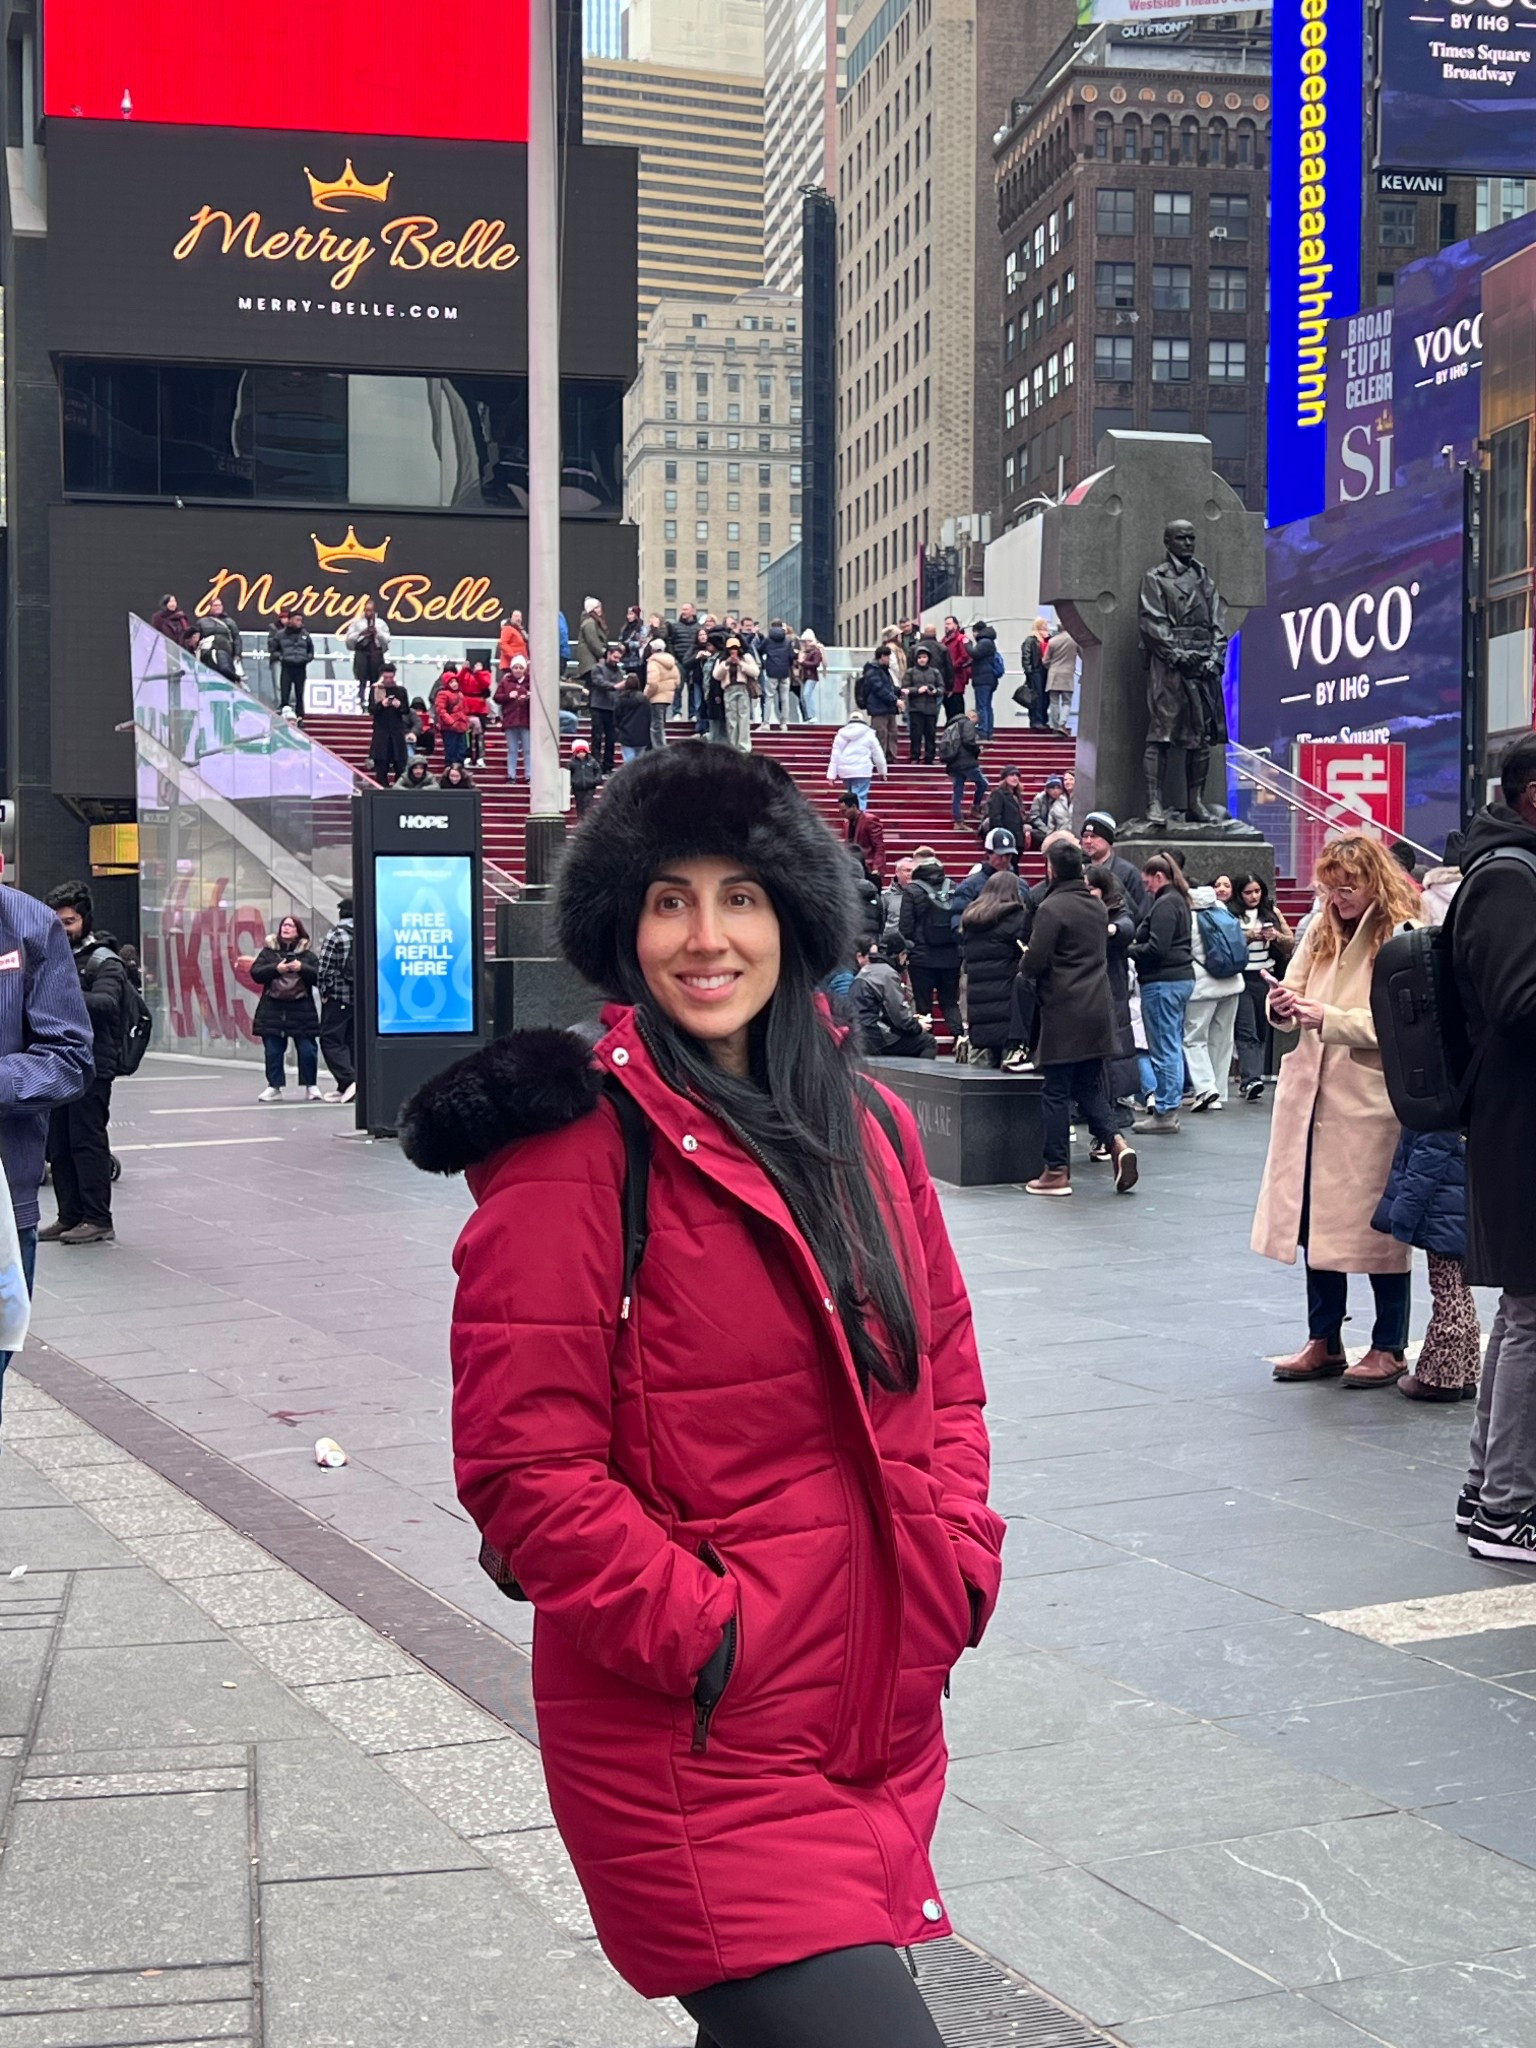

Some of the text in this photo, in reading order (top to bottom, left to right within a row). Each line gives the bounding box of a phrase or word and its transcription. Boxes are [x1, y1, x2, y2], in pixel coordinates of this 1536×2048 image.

[1451, 13, 1510, 32] BY IHG
[1428, 41, 1531, 65] Times Square
[1443, 63, 1517, 86] Broadway
[1381, 175, 1443, 192] KEVANI
[172, 205, 521, 290] Merry Belle
[238, 296, 458, 319] MERRY-BELLE.COM
[1347, 309, 1394, 346] BROAD
[1435, 362, 1469, 386] BY IHG
[1346, 371, 1393, 409] CELEBR
[194, 568, 504, 641] Merry Belle
[1315, 674, 1370, 706] BY IHG
[1324, 753, 1388, 846] tkt
[399, 815, 449, 829] HOPE
[401, 912, 446, 928] FREE
[394, 928, 453, 944] WATER
[395, 945, 454, 960] REFILL
[401, 961, 448, 976] HERE
